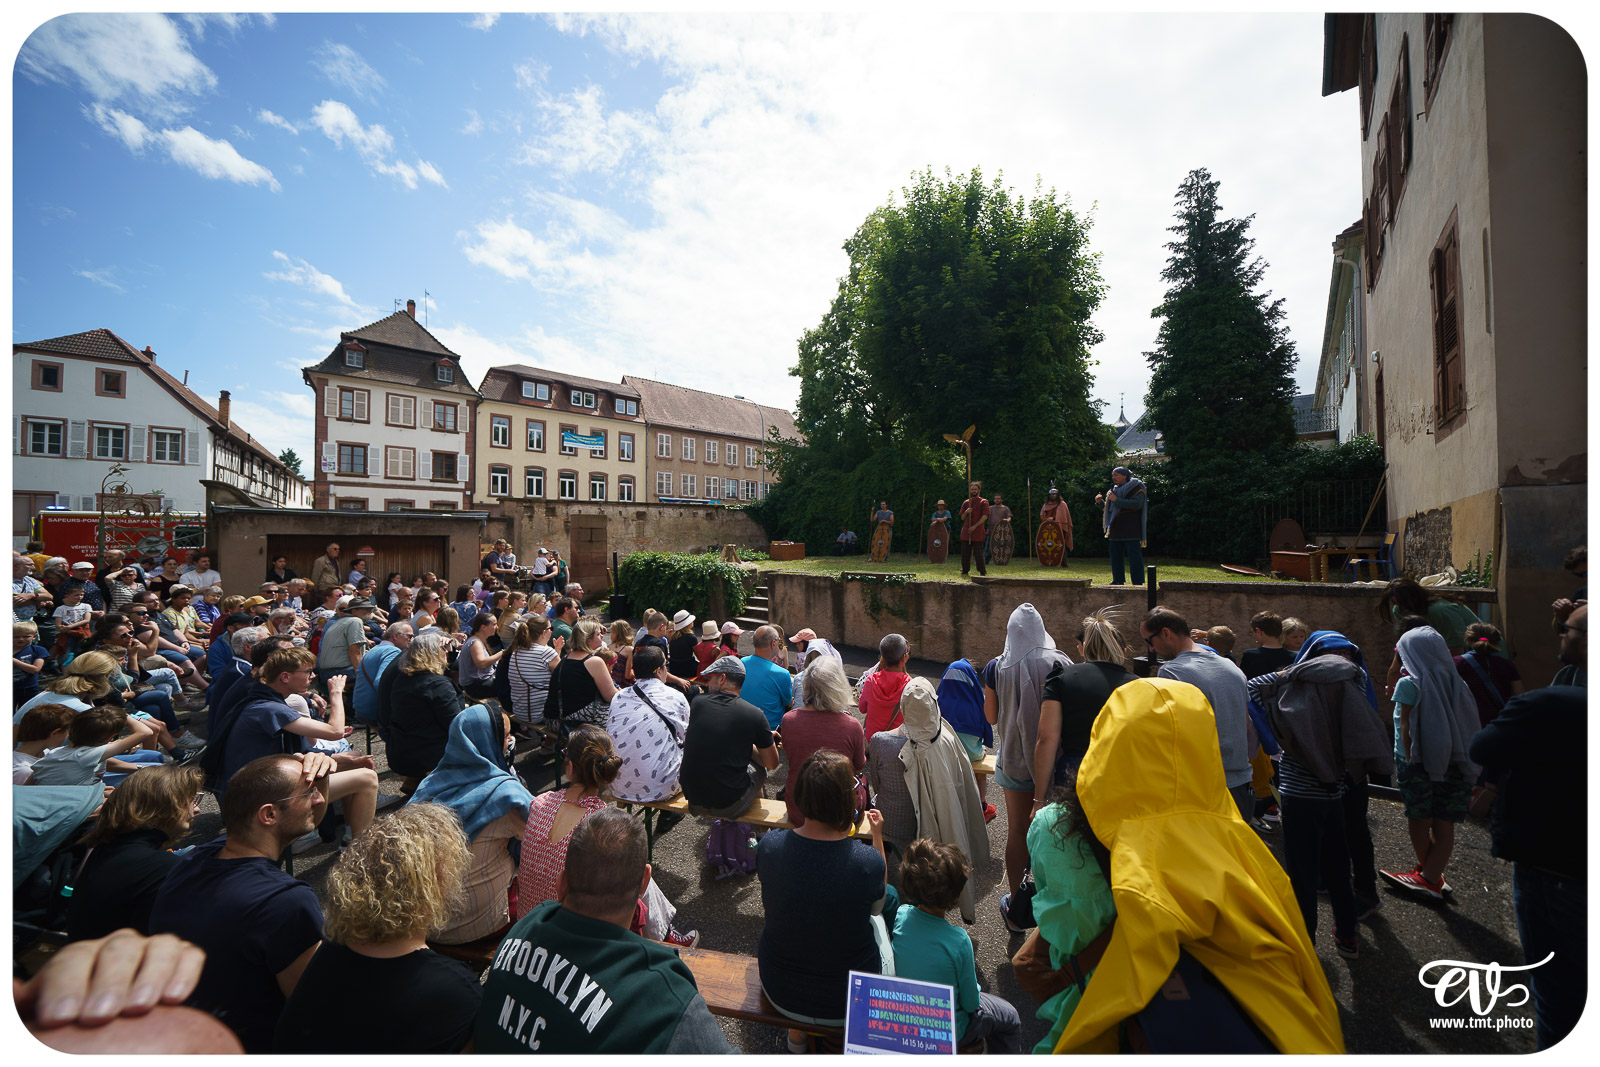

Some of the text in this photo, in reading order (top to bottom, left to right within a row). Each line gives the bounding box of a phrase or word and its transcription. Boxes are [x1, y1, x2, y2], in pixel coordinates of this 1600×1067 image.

[493, 938, 613, 1034] BROOKLYN
[497, 994, 547, 1051] N.Y.C
[902, 1037, 909, 1046] 14
[910, 1039, 917, 1048] 15
[917, 1040, 924, 1049] 16
[924, 1041, 938, 1051] juin
